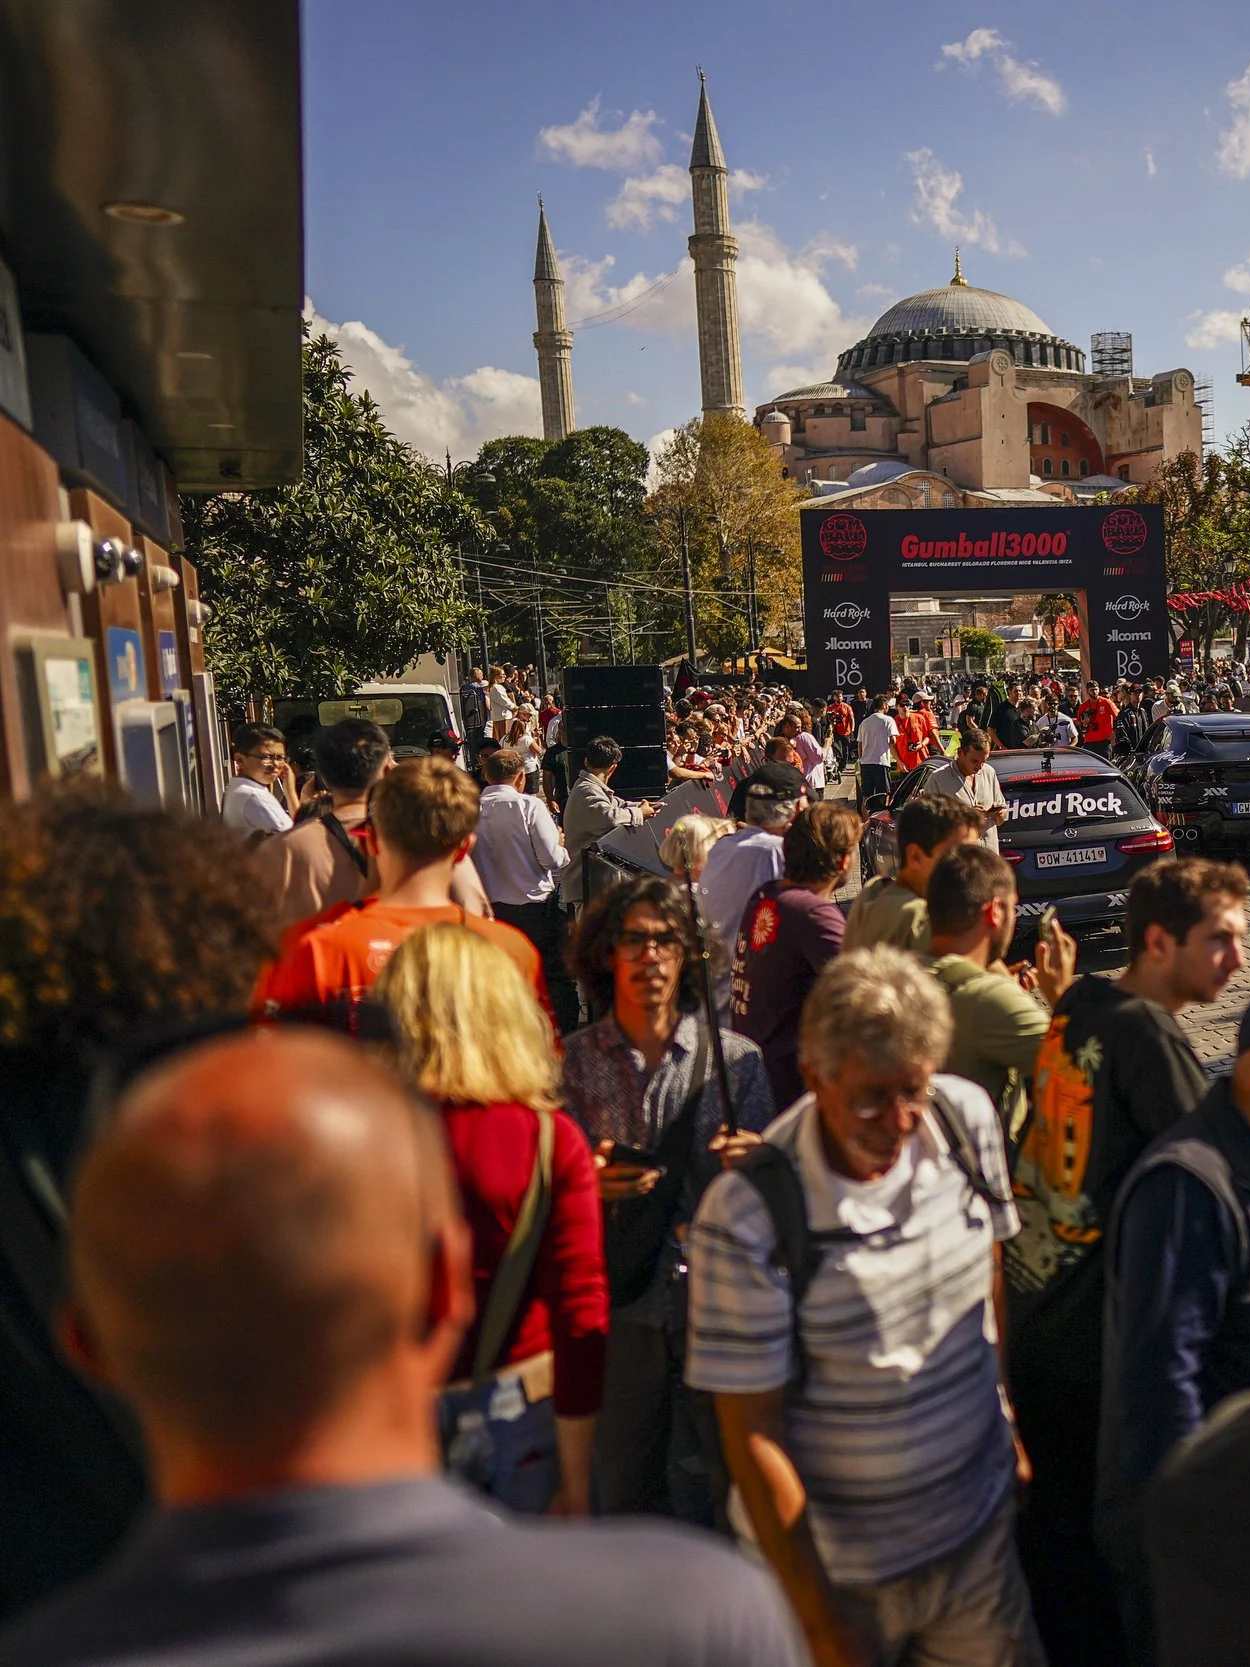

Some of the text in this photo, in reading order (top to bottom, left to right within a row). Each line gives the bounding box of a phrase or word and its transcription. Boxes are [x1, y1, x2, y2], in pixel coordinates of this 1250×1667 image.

[901, 532, 1067, 559] Gumball3000
[823, 607, 871, 619] Hard Rock
[1105, 600, 1150, 611] Hard Rock
[1005, 793, 1062, 821] Hard
